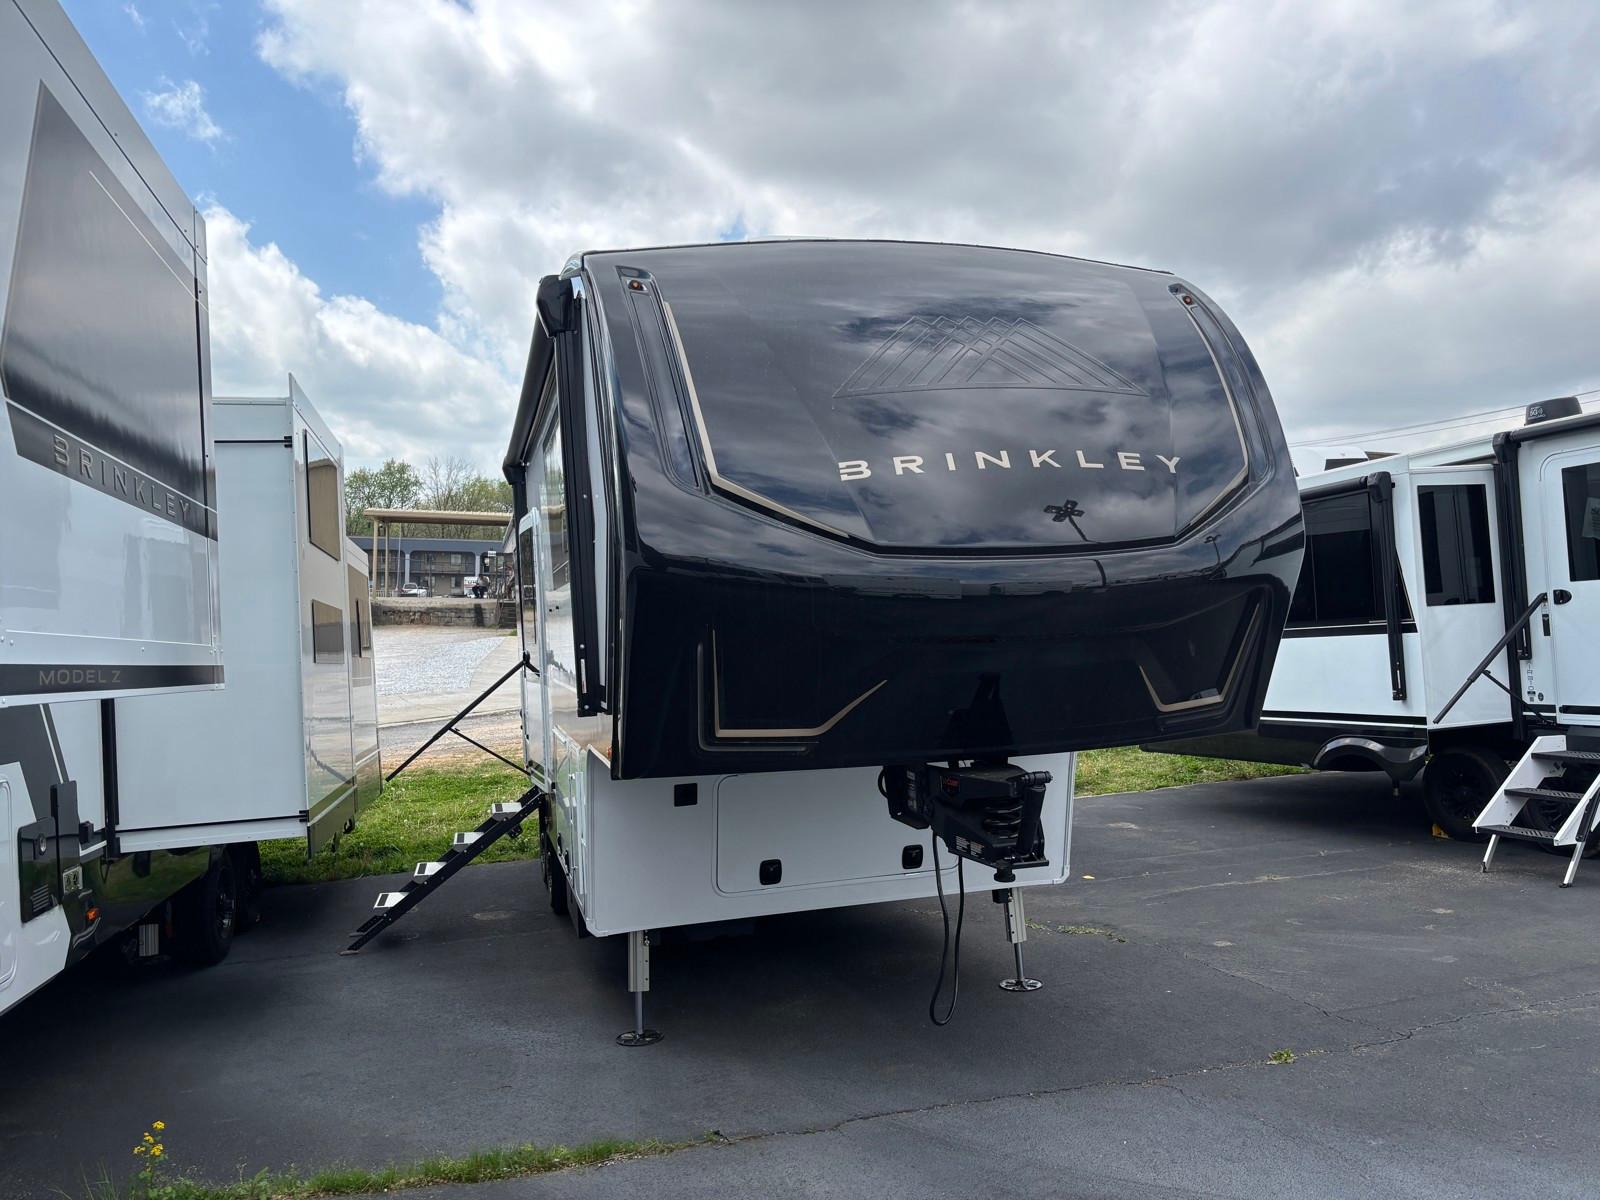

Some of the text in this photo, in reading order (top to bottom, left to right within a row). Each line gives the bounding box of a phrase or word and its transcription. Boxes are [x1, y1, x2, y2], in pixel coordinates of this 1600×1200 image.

[53, 433, 190, 521] BRINKLEY
[838, 449, 1181, 482] BRINKLEY
[39, 670, 121, 686] MODEL Z
